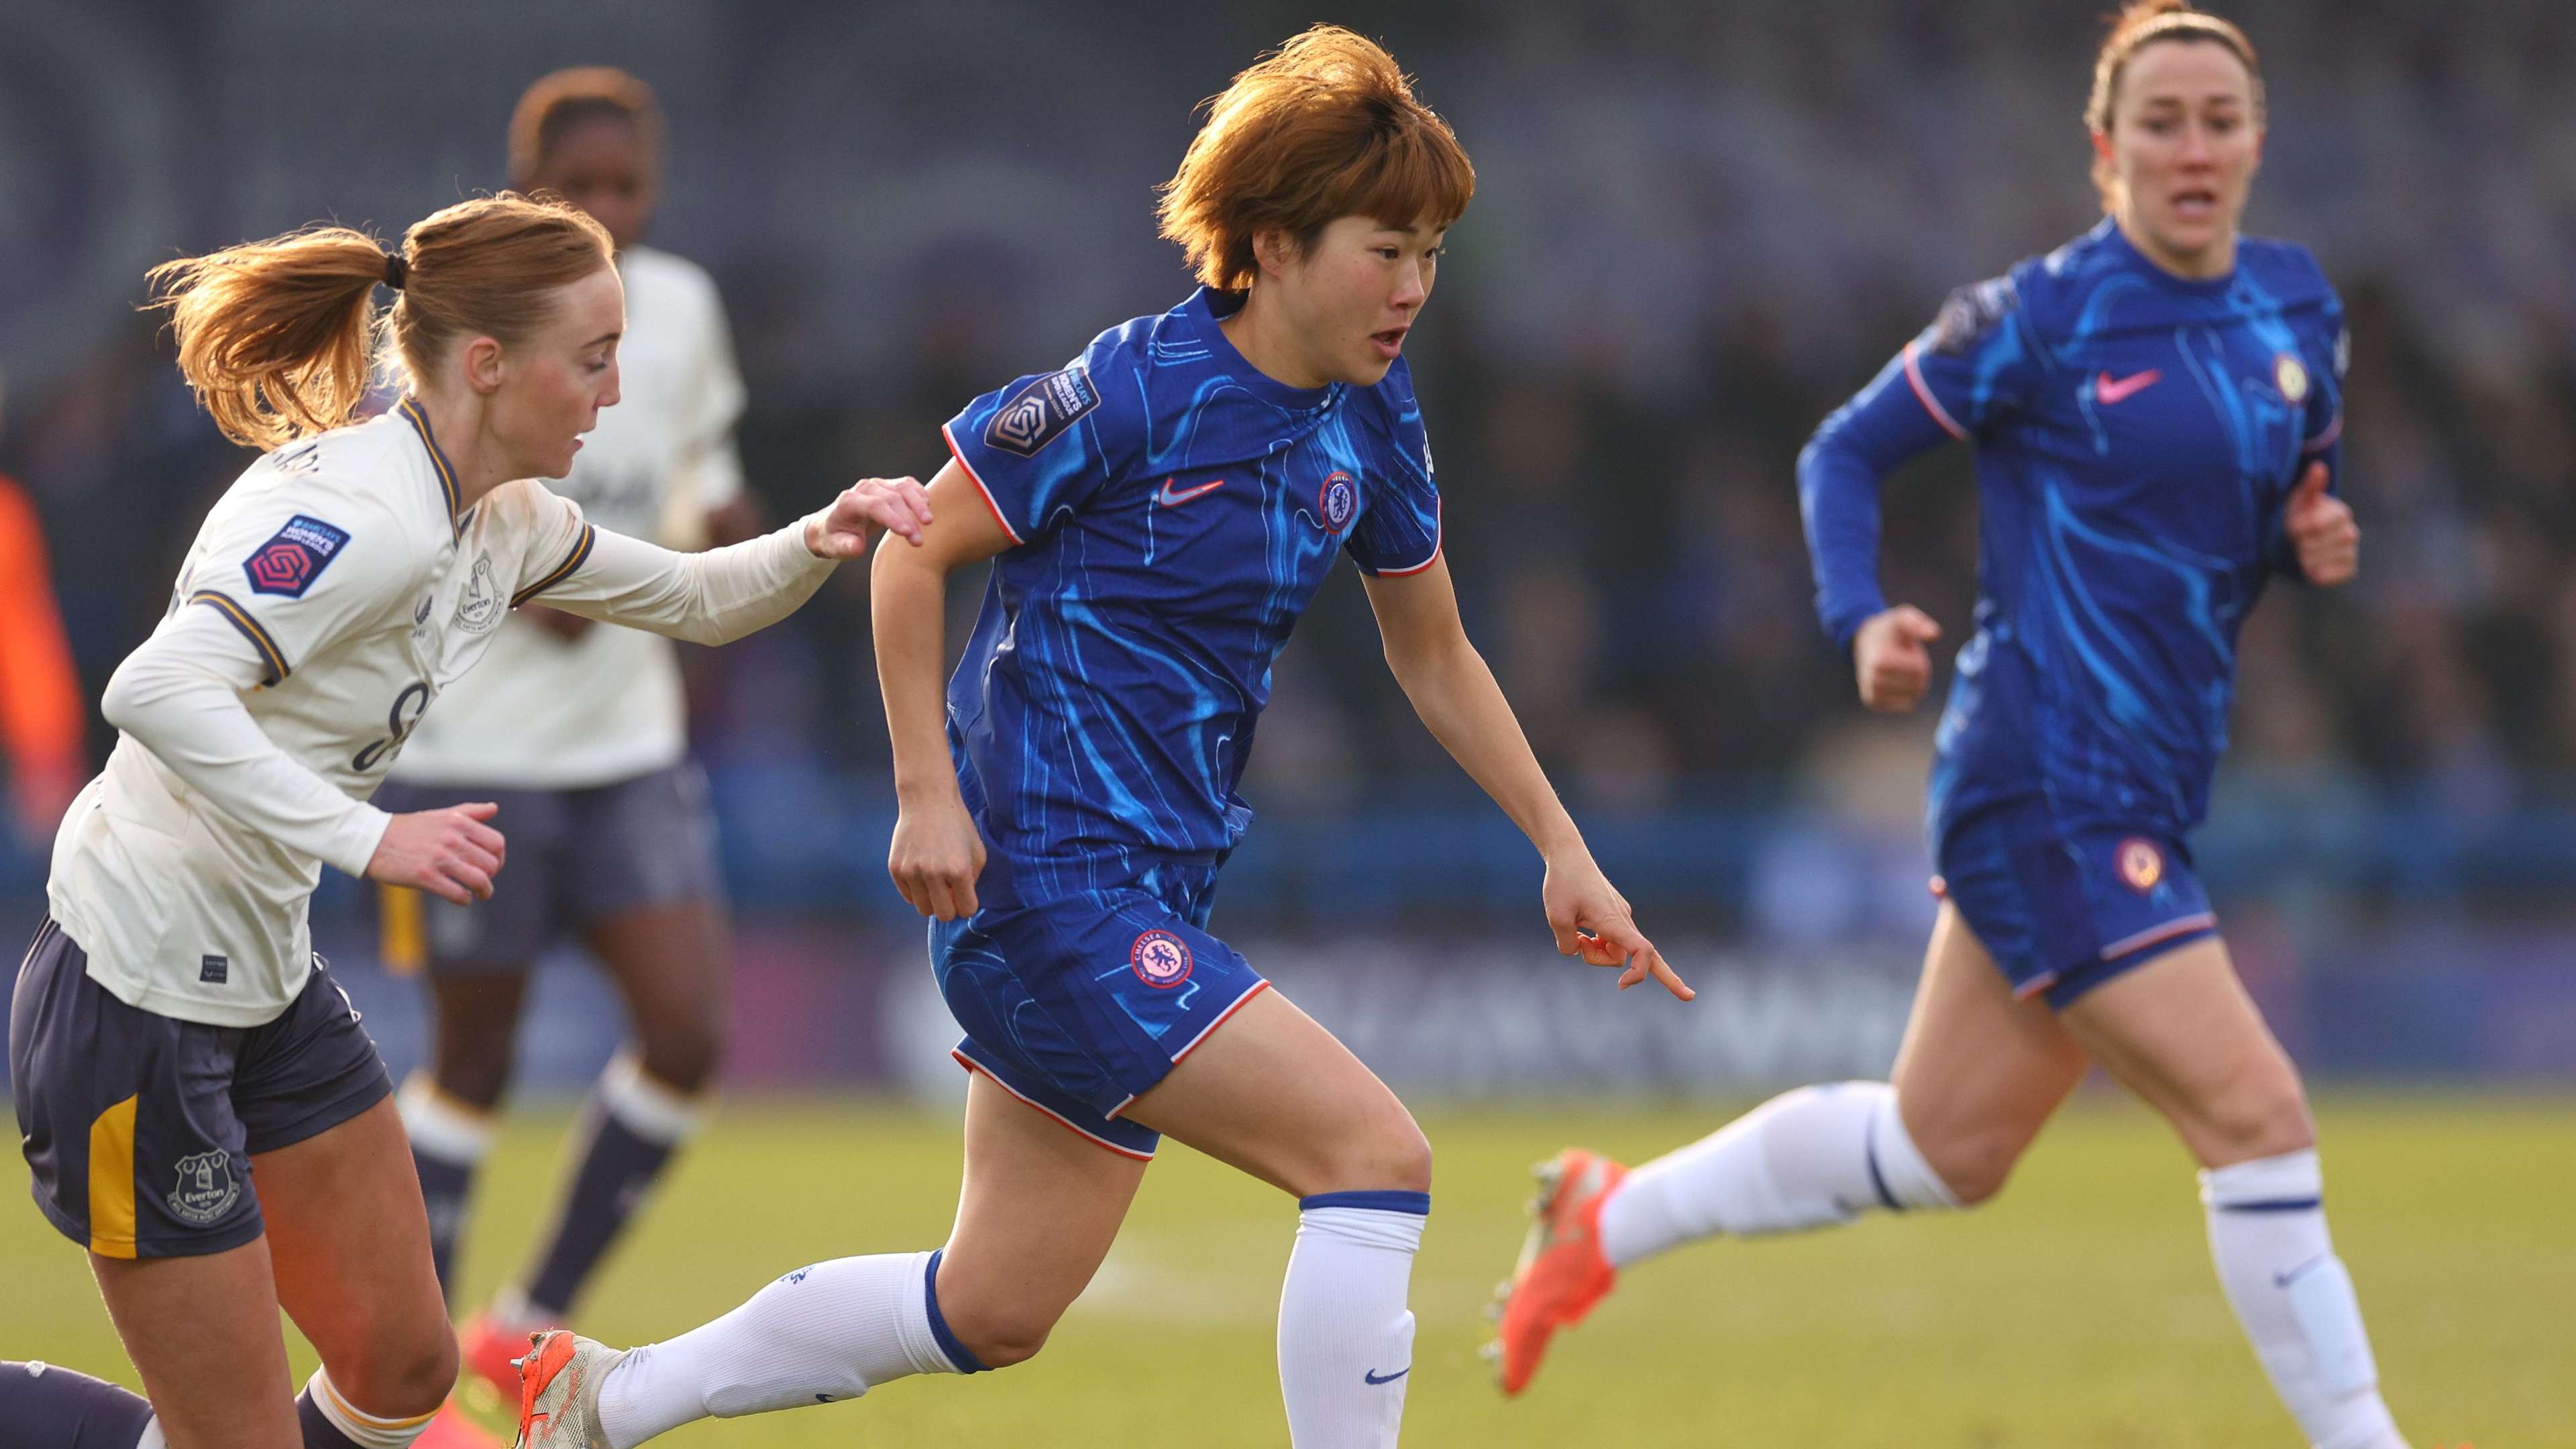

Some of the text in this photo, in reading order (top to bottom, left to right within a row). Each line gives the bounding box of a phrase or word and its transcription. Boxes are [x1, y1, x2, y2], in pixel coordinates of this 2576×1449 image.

[462, 598, 491, 614] Everton
[1134, 933, 1161, 961] CHELSEA
[185, 1188, 225, 1203] Everton
